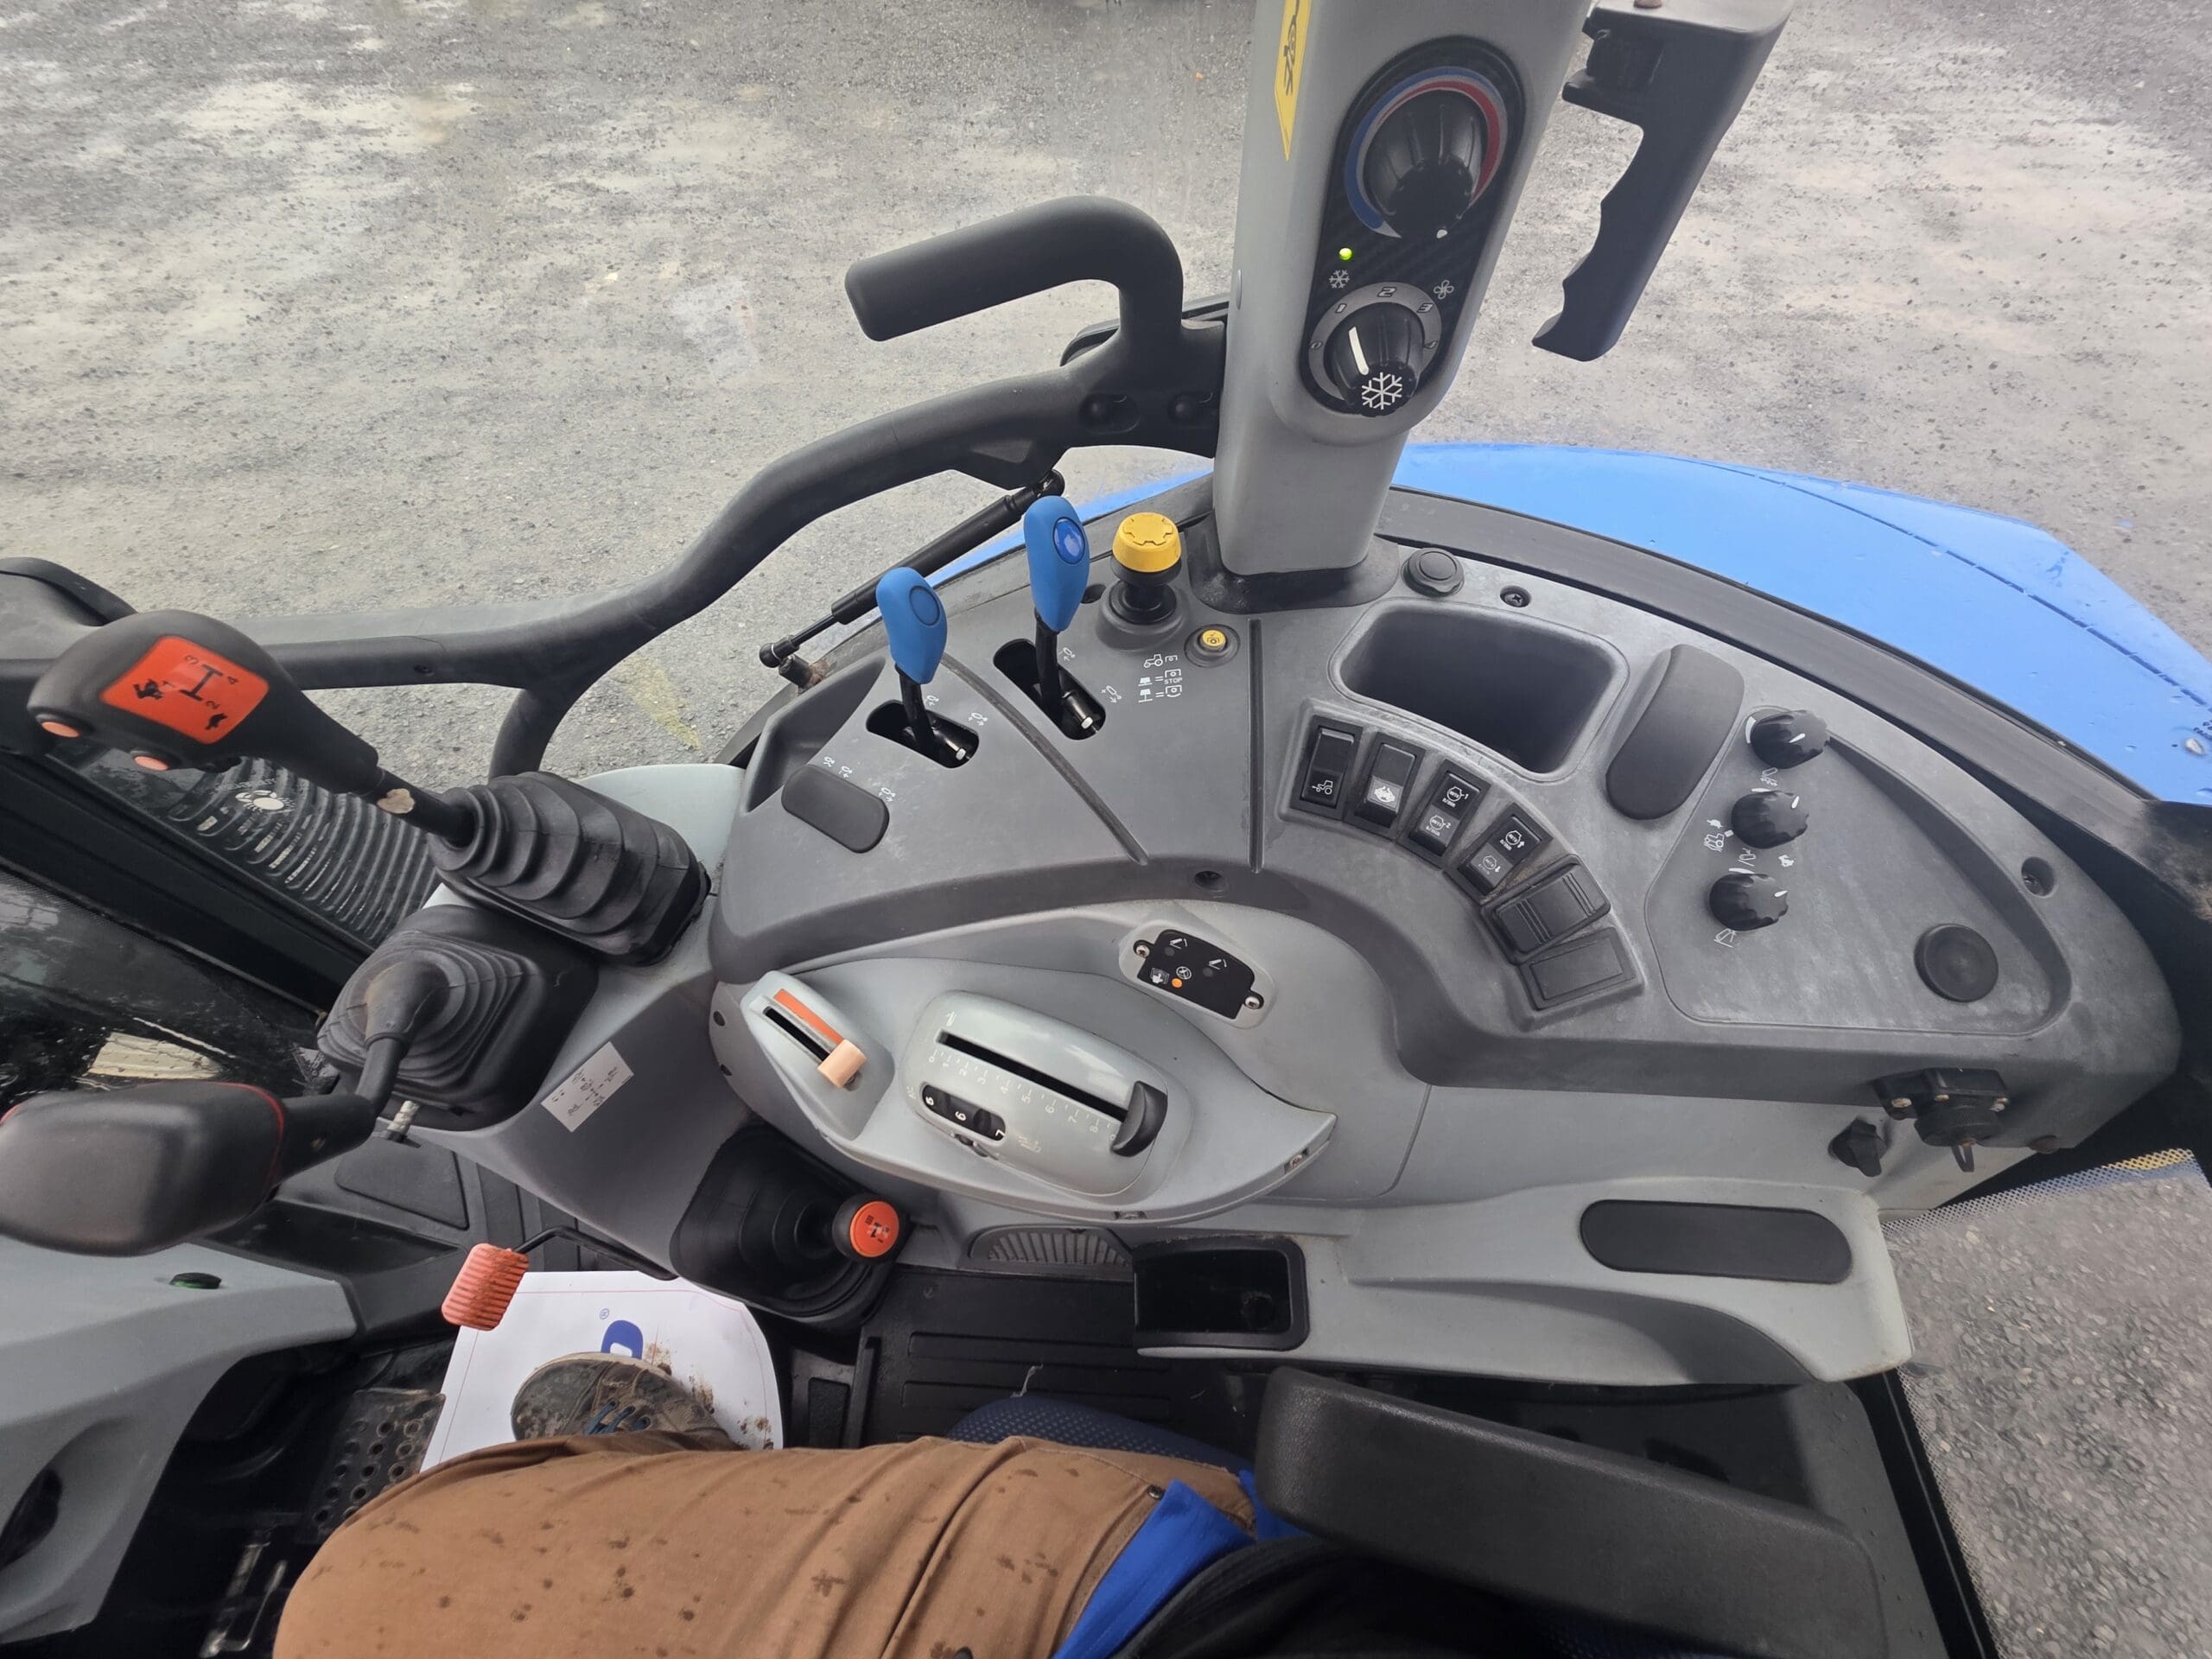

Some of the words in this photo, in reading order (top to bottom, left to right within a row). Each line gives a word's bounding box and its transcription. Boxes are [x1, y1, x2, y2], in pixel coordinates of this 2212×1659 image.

[1376, 286, 1397, 298] 2
[1334, 303, 1348, 314] 1
[1416, 303, 1434, 314] 3
[184, 655, 199, 664] 3
[227, 676, 239, 685] 4
[1164, 677, 1183, 685] STOP
[205, 700, 220, 709] 2
[955, 1111, 966, 1122] 6
[995, 1128, 1006, 1137] 7
